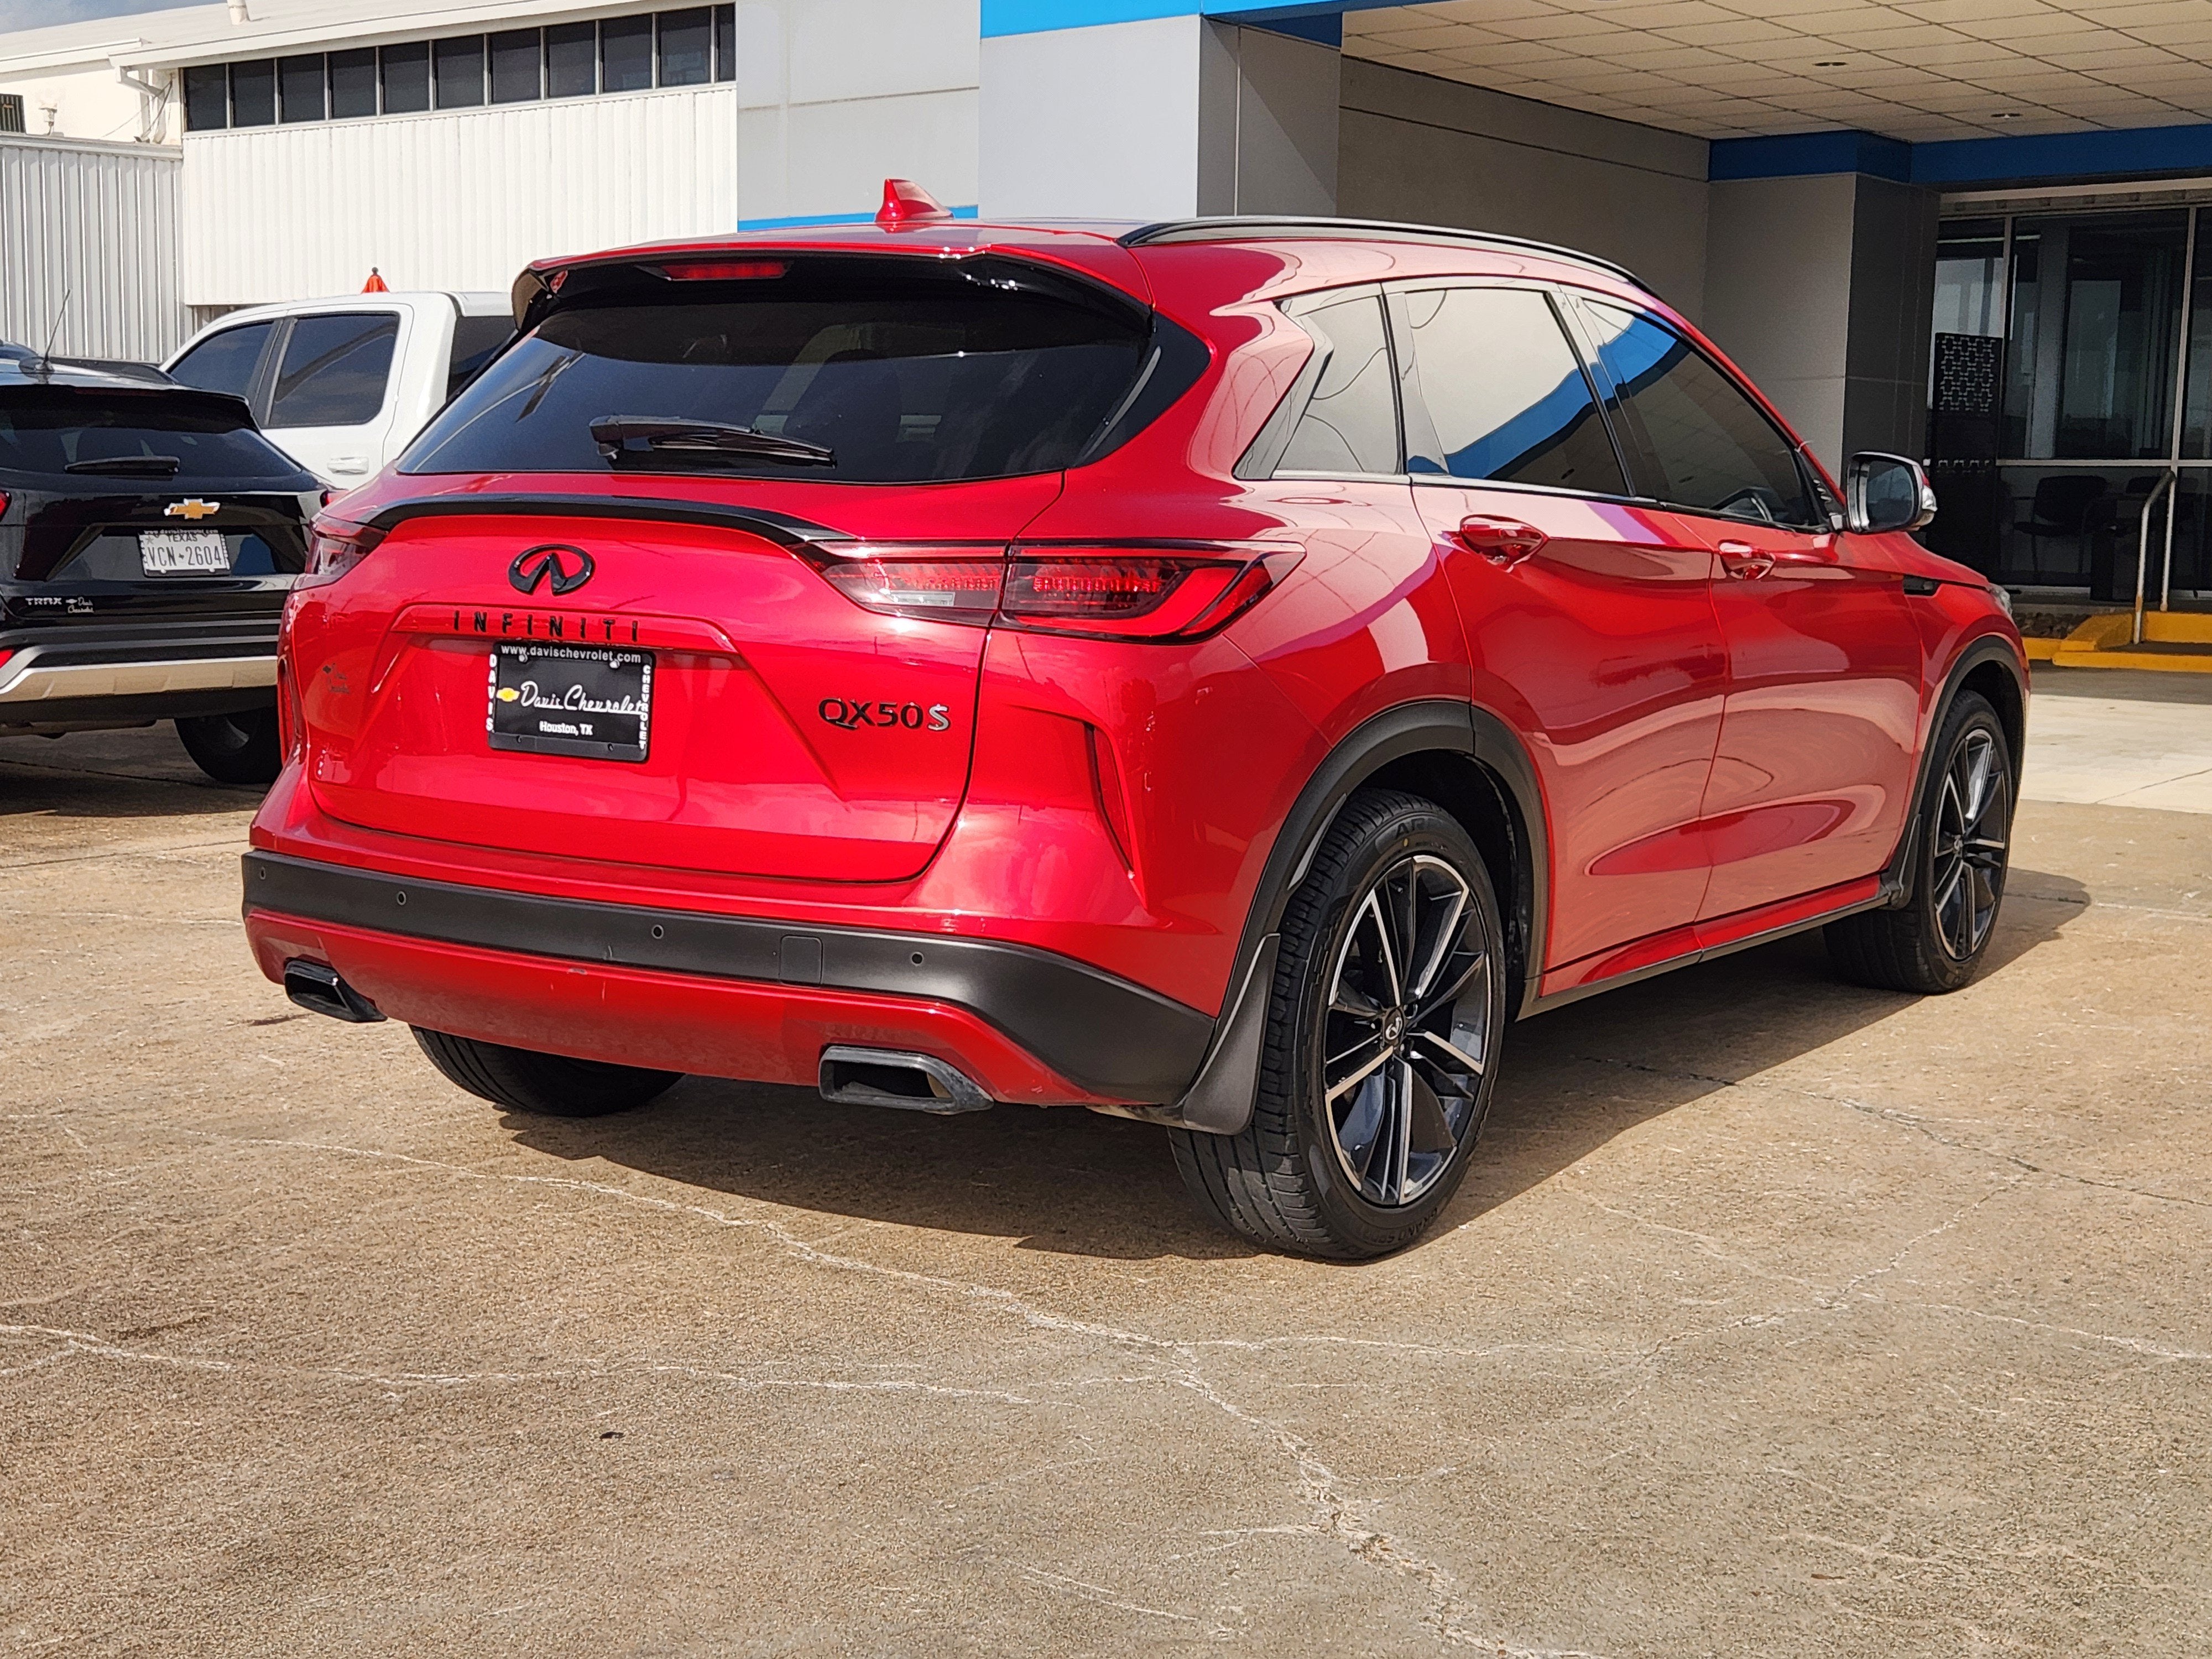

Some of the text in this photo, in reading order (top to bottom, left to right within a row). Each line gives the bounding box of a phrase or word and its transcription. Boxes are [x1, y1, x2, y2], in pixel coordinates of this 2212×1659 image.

[168, 534, 198, 542] TEXAS
[147, 546, 177, 567] VCN
[185, 545, 222, 566] 2604
[25, 597, 62, 606] TRAX
[453, 610, 639, 641] INFINITI
[500, 645, 641, 663] www.davischevrolet.com
[486, 654, 497, 731] DAVIS
[520, 680, 642, 714] Davis Chevrolet
[639, 664, 651, 750] CHEVROLET
[539, 721, 593, 736] Houston, TX
